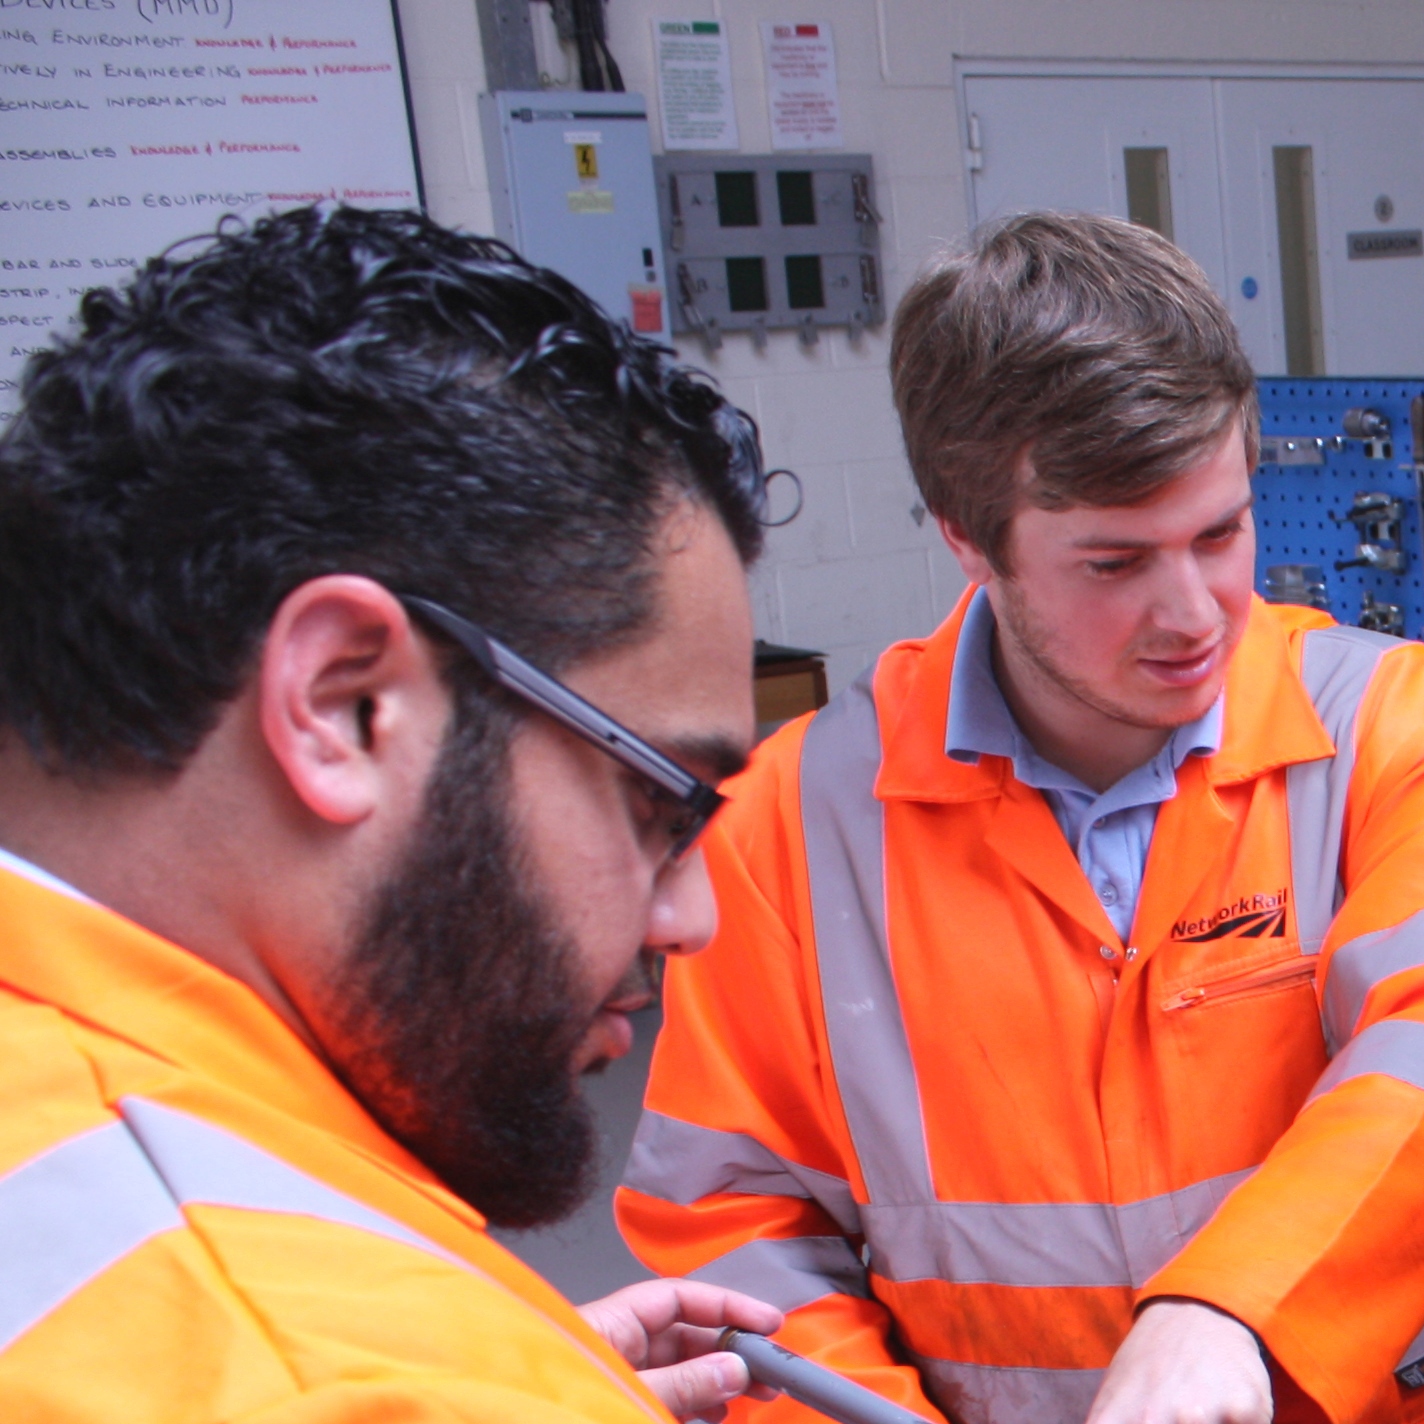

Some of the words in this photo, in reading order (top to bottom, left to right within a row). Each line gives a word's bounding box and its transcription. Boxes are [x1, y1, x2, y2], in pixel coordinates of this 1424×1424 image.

[52, 29, 184, 48] ENVIRONMENT
[75, 68, 92, 78] IN
[104, 63, 241, 79] ENGINEERING
[106, 96, 226, 108] INFORMATION
[88, 195, 131, 208] AND
[143, 191, 261, 210] EQUIPMENT
[1353, 237, 1419, 252] CLASSROOM
[2, 259, 41, 270] BAR
[50, 259, 82, 269] AND
[1170, 901, 1250, 940] Network
[1252, 887, 1288, 912] Rail
